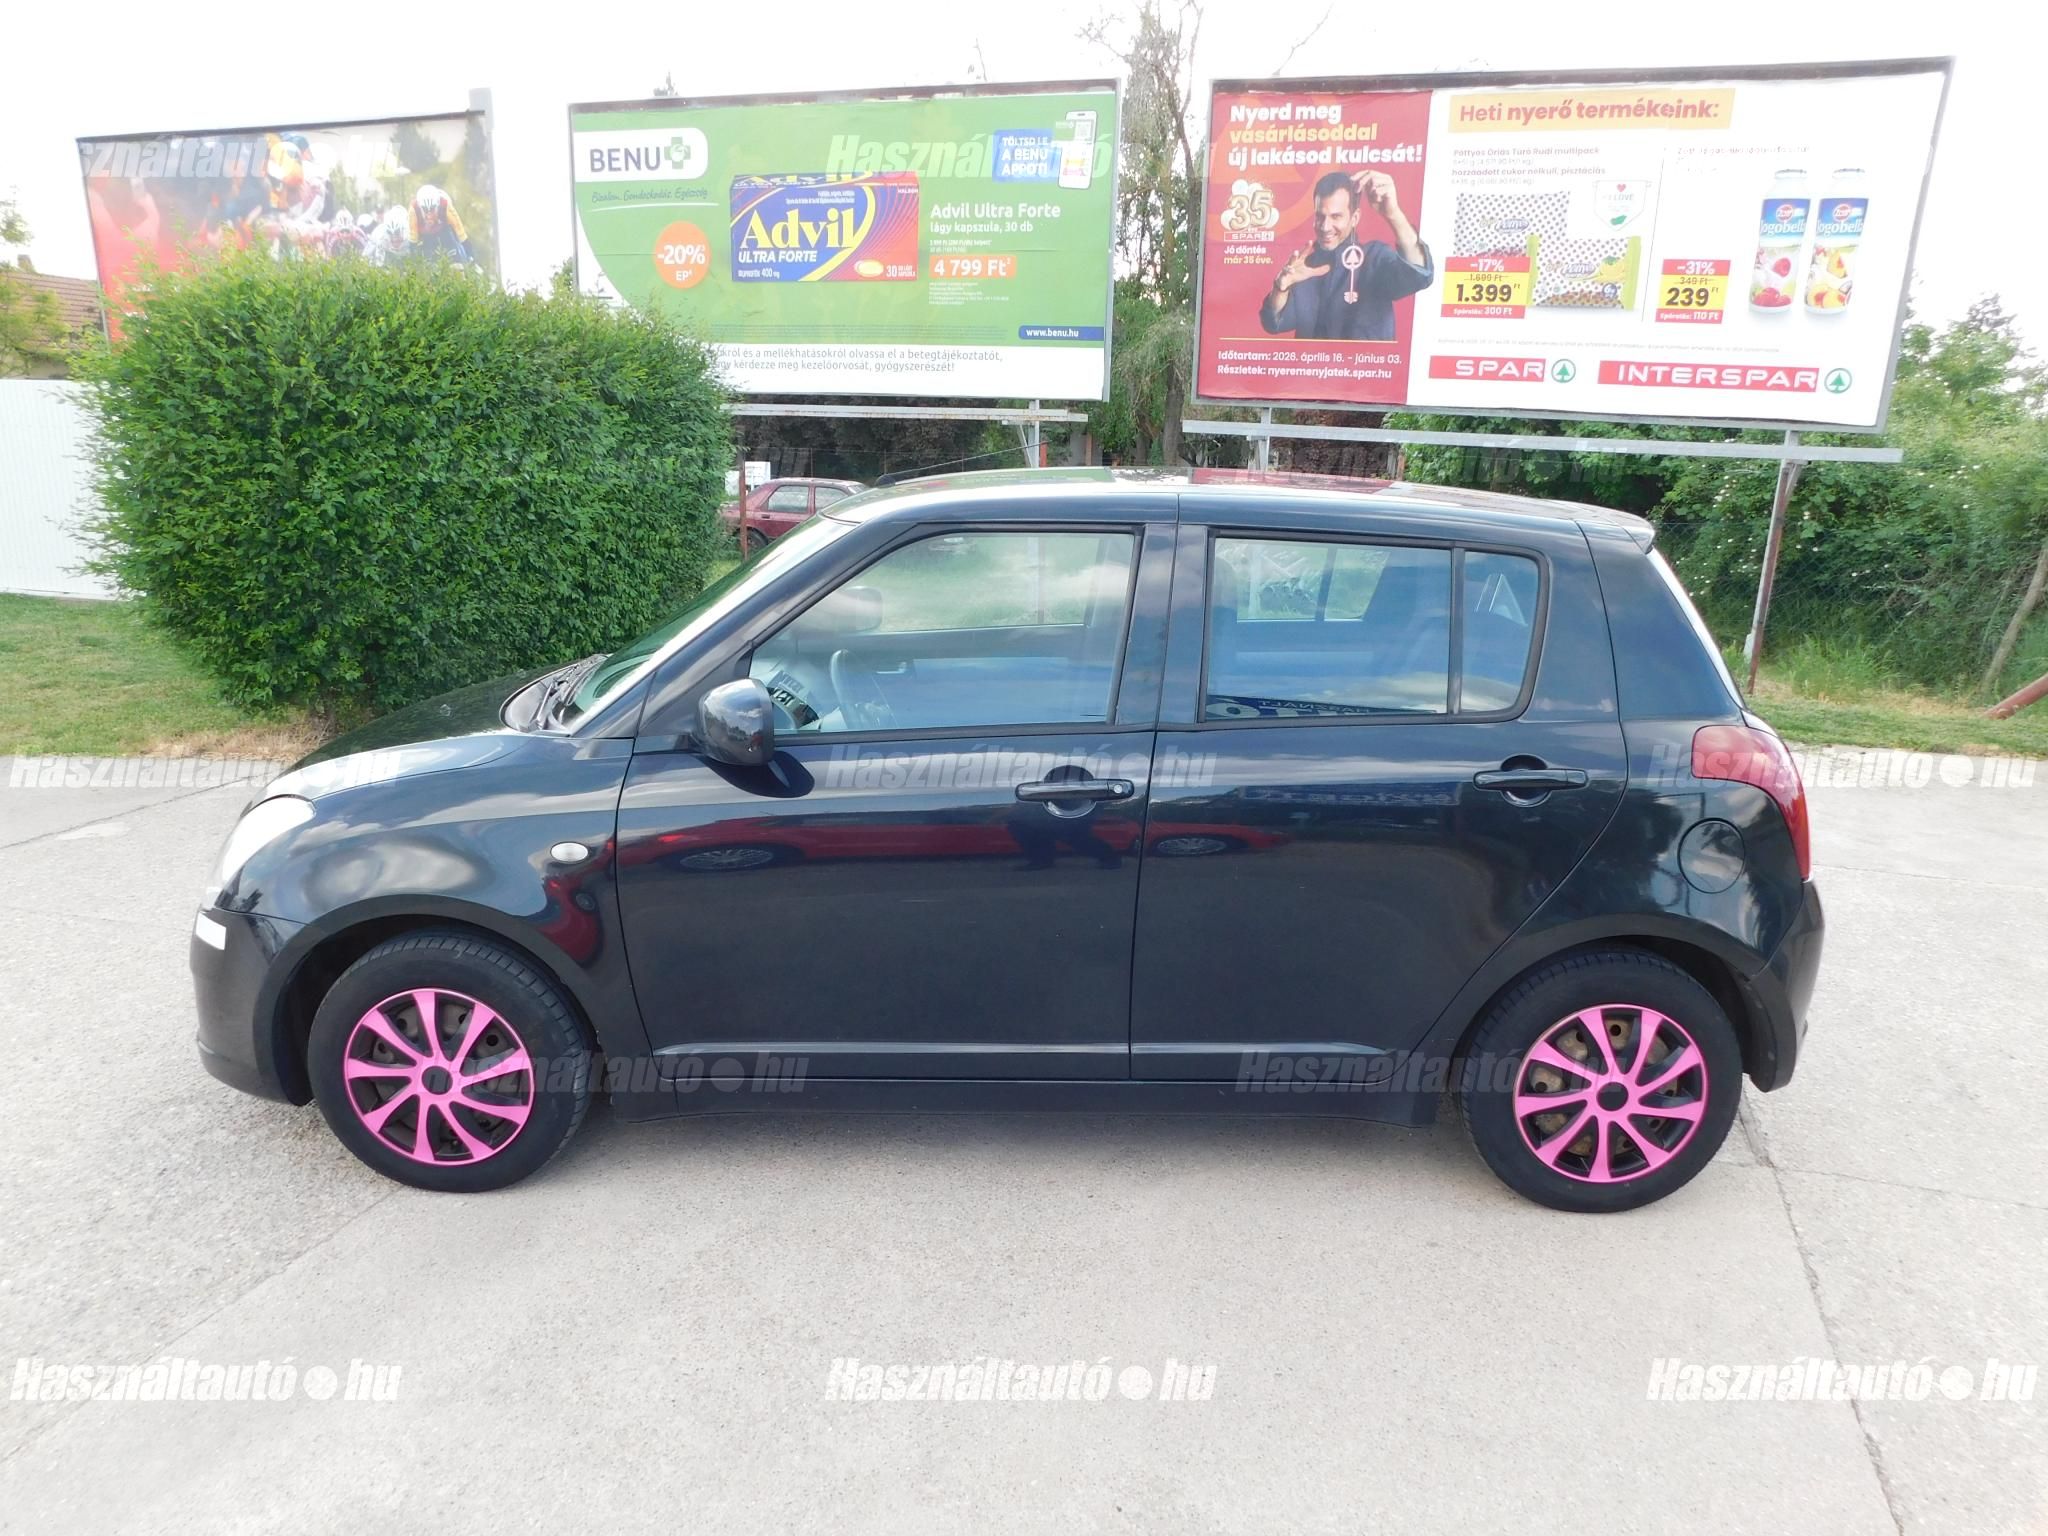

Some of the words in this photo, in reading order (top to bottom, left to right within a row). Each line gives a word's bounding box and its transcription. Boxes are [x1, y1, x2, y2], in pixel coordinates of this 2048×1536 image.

[1230, 104, 1292, 128] Nyerd
[1295, 104, 1342, 125] meg
[1460, 103, 1502, 121] Heti
[1507, 99, 1573, 126] nyerő
[1577, 97, 1719, 119] termékeink:
[1229, 123, 1377, 144] vásárlásoddal
[590, 147, 661, 172] BENU
[1002, 148, 1011, 160] A
[1014, 148, 1048, 160] BENU
[1228, 149, 1247, 171] új
[1251, 147, 1331, 166] lakásod
[1336, 144, 1423, 164] kulcsát!
[930, 203, 970, 218] Advil
[974, 203, 1013, 218] Ultra
[1018, 203, 1061, 218] Forte
[1229, 190, 1272, 230] 35
[739, 207, 856, 249] Advil
[930, 222, 952, 235] lágy
[955, 222, 1002, 235] kapszula,
[1005, 221, 1018, 232] 30
[1020, 221, 1033, 232] db
[738, 251, 777, 263] ULTRA
[778, 250, 817, 263] FORTE
[1224, 245, 1235, 254] Jó
[886, 264, 897, 277] 30
[934, 260, 945, 276] 4
[950, 260, 982, 276] 799
[1470, 259, 1504, 272] -17%
[1677, 261, 1716, 274] -31%
[1456, 284, 1512, 302] 1.399
[1665, 287, 1710, 307] 239
[1484, 307, 1502, 315] 300
[1503, 307, 1512, 315] Ft
[1692, 311, 1707, 320] 110
[1708, 311, 1719, 320] Ft
[1026, 327, 1080, 339] www.benu.hu
[743, 347, 753, 358] és
[763, 347, 846, 359] mellékhatásokról
[849, 349, 885, 360] olvassa
[887, 349, 897, 359] el
[908, 348, 1003, 363] betegtájékoztatót,
[1218, 350, 1271, 362] Időtartam:
[1300, 352, 1330, 364] április
[1354, 353, 1385, 365] június
[1387, 354, 1402, 364] 03.
[734, 360, 776, 369] kérdezze
[778, 361, 799, 371] meg
[801, 359, 872, 372] kezelőorvosát,
[874, 359, 955, 373] gyógyszerészét!
[1217, 365, 1267, 376] Részletek:
[1456, 359, 1544, 378] SPAR
[1617, 364, 1818, 389] INTERSPAR
